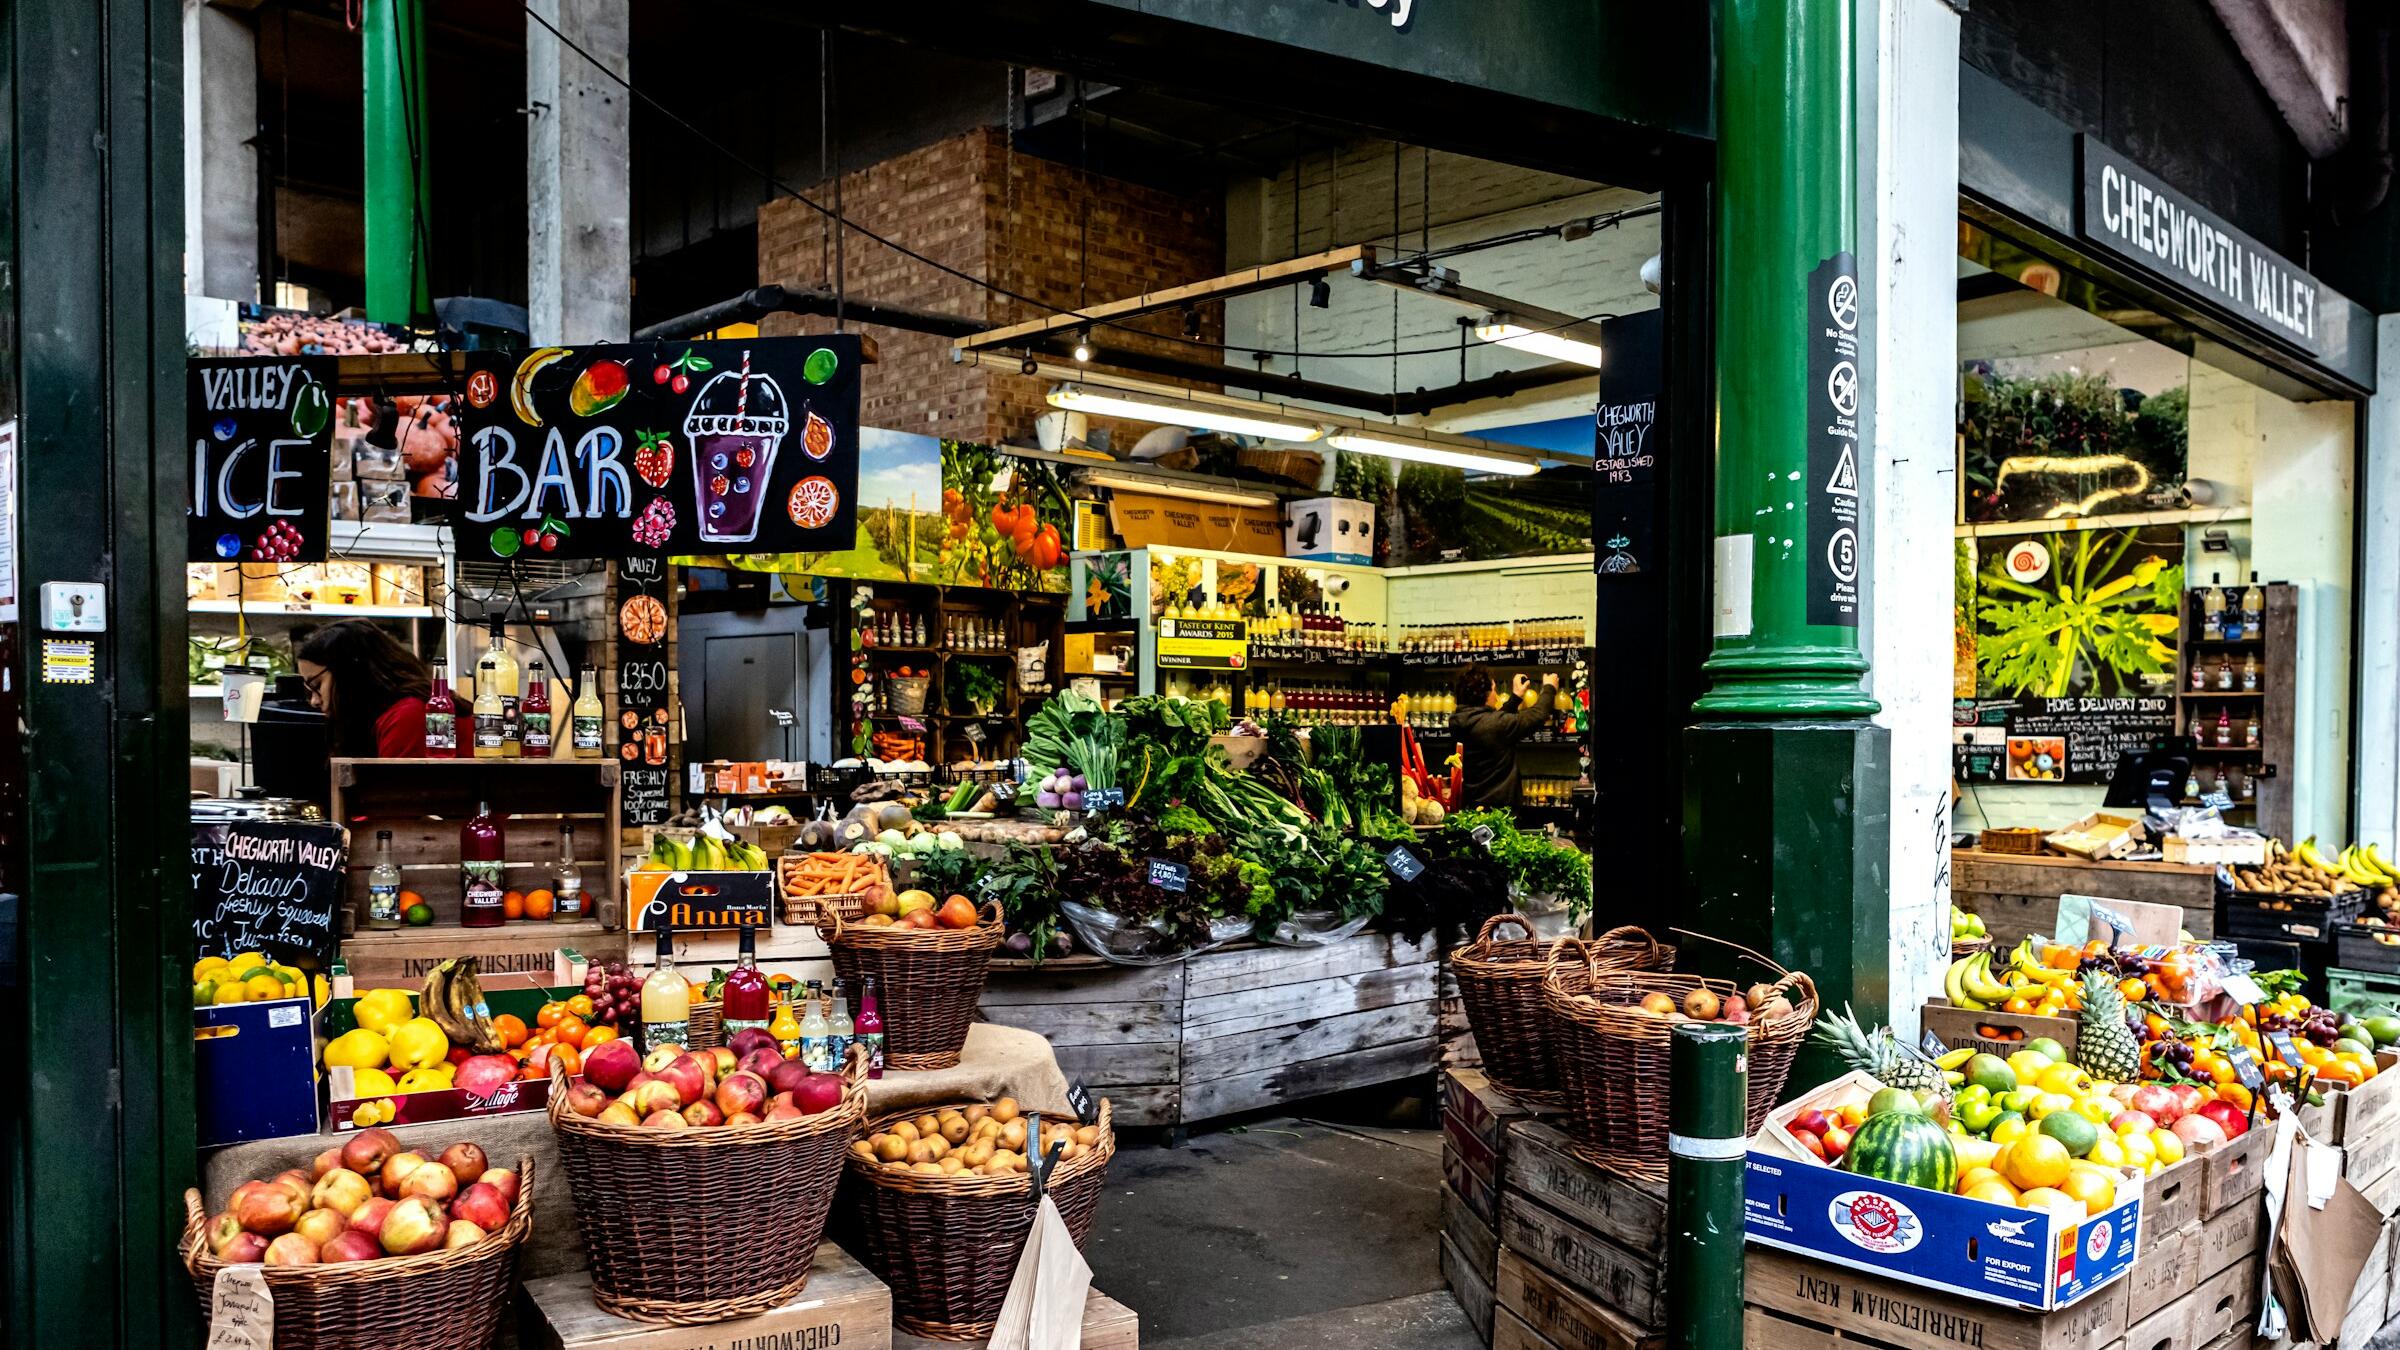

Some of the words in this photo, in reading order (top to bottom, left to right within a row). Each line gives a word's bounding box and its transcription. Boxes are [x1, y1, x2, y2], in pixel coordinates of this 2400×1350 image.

[2102, 165, 2243, 302] CHEGWORTH
[2250, 252, 2315, 339] VALLEY
[1826, 328, 1838, 338] No
[200, 364, 299, 411] VALLEY
[1596, 400, 1656, 429] CHEGWORTH
[1599, 424, 1650, 459] VALLEY
[1595, 455, 1654, 472] ESTABLISHED
[193, 438, 312, 520] ICE
[464, 425, 633, 522] BAR
[1609, 470, 1633, 484] 1983
[1840, 539, 1853, 564] 5
[1835, 582, 1855, 594] Please
[1830, 593, 1847, 603] drive
[1839, 604, 1853, 613] care
[1178, 621, 1200, 631] TASTE
[1201, 622, 1213, 630] OF
[1214, 622, 1236, 631] KENT
[1178, 629, 1214, 639] AWARDS
[1215, 631, 1235, 639] 2015
[1160, 655, 1192, 665] WINNER
[2046, 698, 2076, 713] HOME
[2079, 697, 2136, 712] DELIVERY
[2139, 698, 2167, 712] INFO
[503, 723, 518, 732] ORTH
[2119, 733, 2143, 742] NEXT
[623, 769, 668, 786] FRESHLY
[224, 832, 295, 864] CHEGWORTH
[298, 839, 341, 872] VALLEY
[218, 859, 308, 903] Delicious
[473, 897, 499, 905] VALLEY
[215, 893, 274, 930] freshly
[670, 902, 768, 926] Anna
[473, 950, 555, 975] RRIETSHA
[1752, 1162, 1783, 1177] SELECTED
[1855, 1198, 1871, 1212] RED
[1872, 1198, 1896, 1220] SEAL
[1994, 1223, 2016, 1233] CYPRUS
[2003, 1237, 2035, 1249] PHASSOURI
[1985, 1256, 2001, 1267] FOR
[2001, 1259, 2032, 1274] EXPORT
[1796, 1274, 1841, 1309] KENT
[1851, 1289, 1985, 1349] HARRIETSHAM
